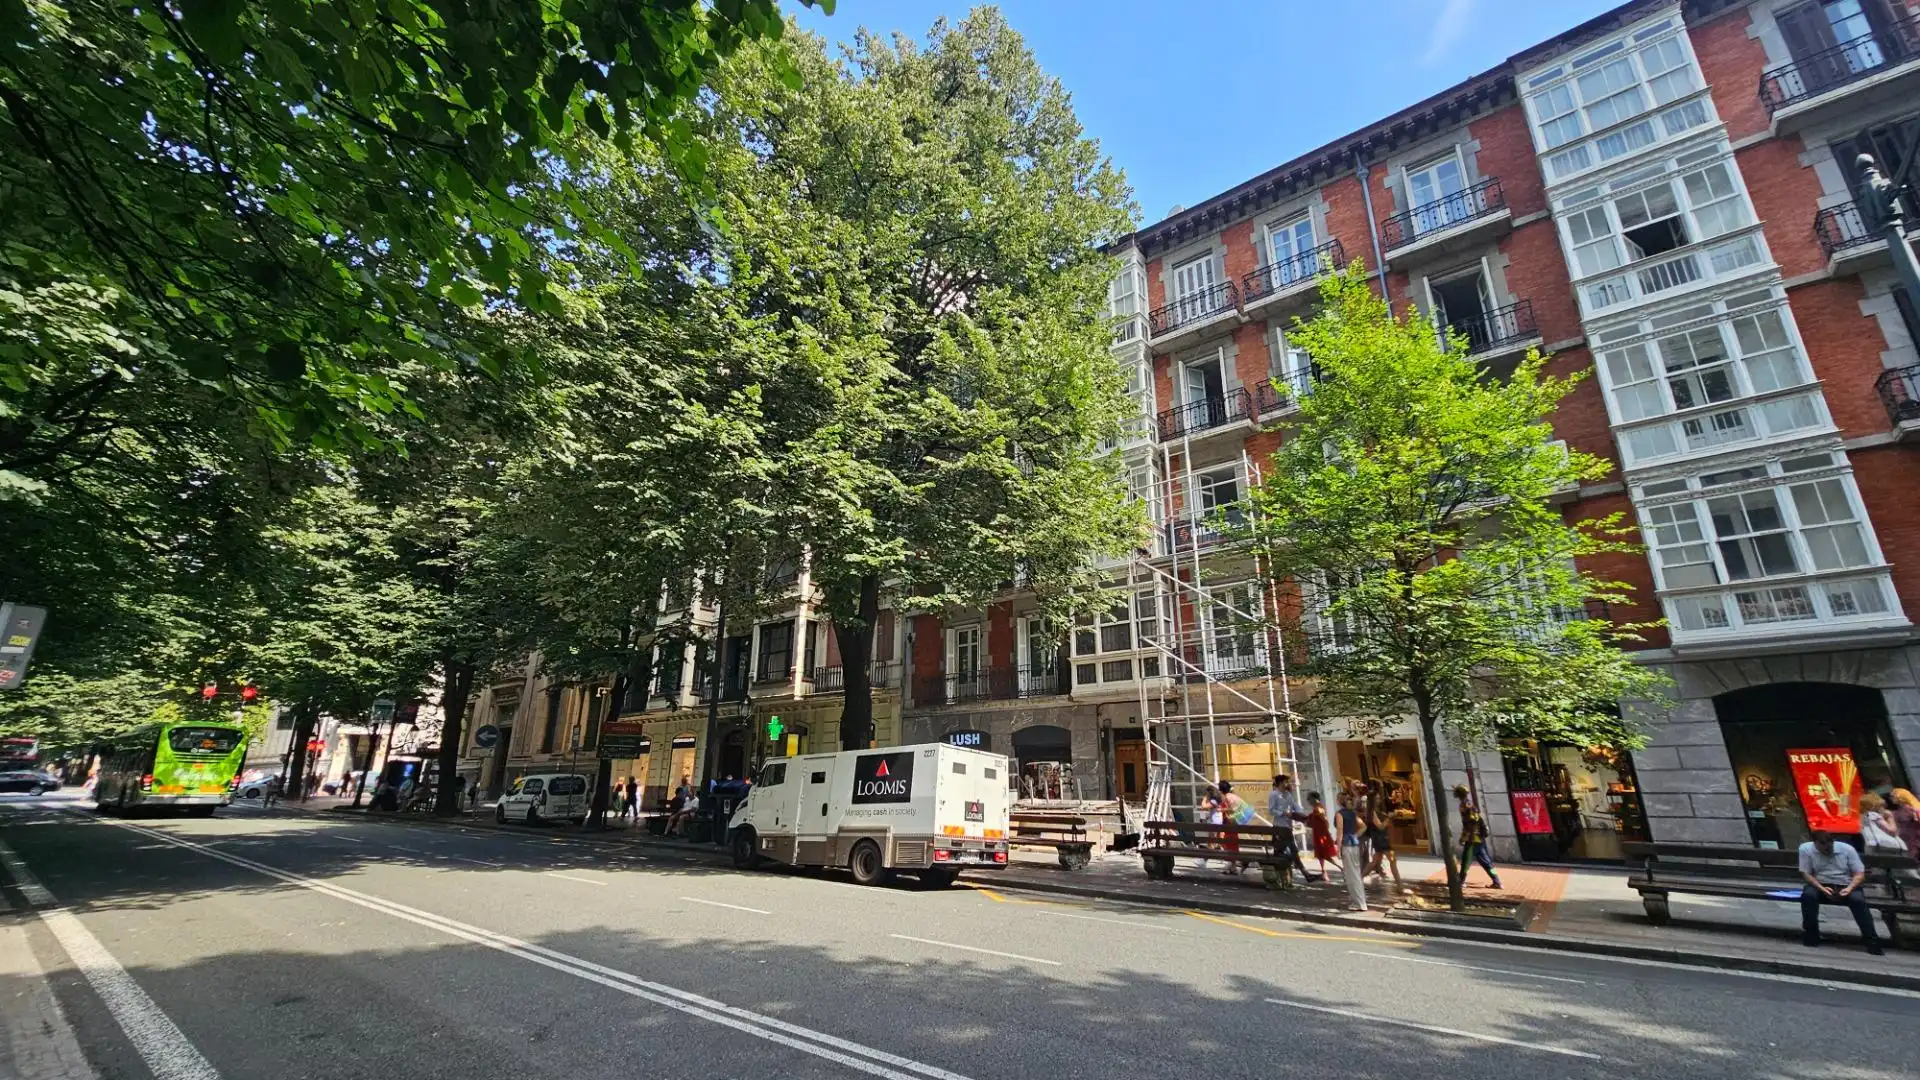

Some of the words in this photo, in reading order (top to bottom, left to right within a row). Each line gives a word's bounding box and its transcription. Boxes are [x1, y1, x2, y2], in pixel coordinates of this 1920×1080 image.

[950, 733, 980, 745] LUSH
[1789, 753, 1851, 764] REBAJAS
[857, 779, 907, 796] LOOMIS
[845, 807, 872, 818] Managing
[873, 807, 887, 816] cash
[888, 807, 895, 815] in
